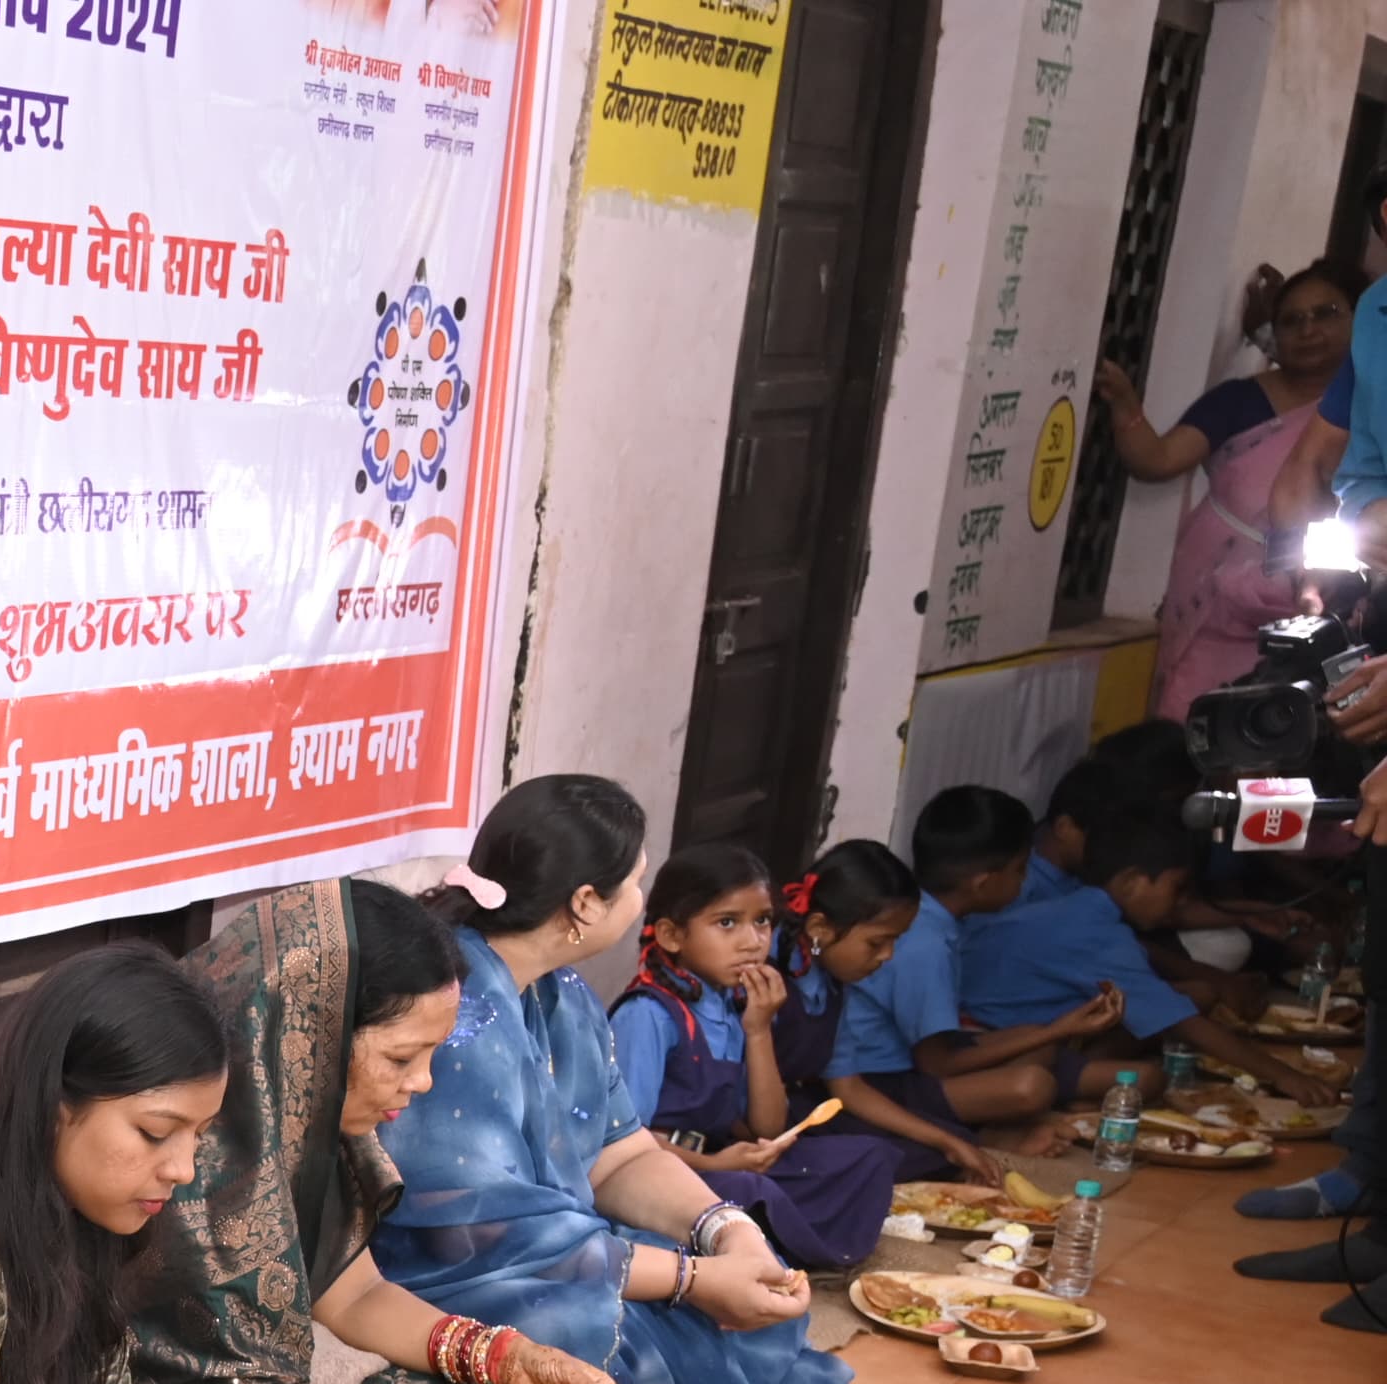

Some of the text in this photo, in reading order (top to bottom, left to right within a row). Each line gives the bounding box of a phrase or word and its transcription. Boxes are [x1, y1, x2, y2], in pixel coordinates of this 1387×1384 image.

[66, 0, 181, 59] 2024
[305, 39, 320, 66] श्री
[418, 62, 433, 88] श्री
[471, 78, 492, 99] साय
[693, 142, 736, 178] 93810
[88, 205, 154, 293] देवी
[163, 235, 237, 299] साय
[241, 228, 290, 304] जी
[137, 338, 209, 402] साय
[214, 327, 264, 404] जी
[205, 589, 253, 638] पर
[30, 727, 187, 833] माध्यमिक
[191, 731, 278, 811] शाला,
[290, 718, 363, 789] श्याम
[367, 709, 425, 772] नगर
[1263, 808, 1283, 837] ZEE
